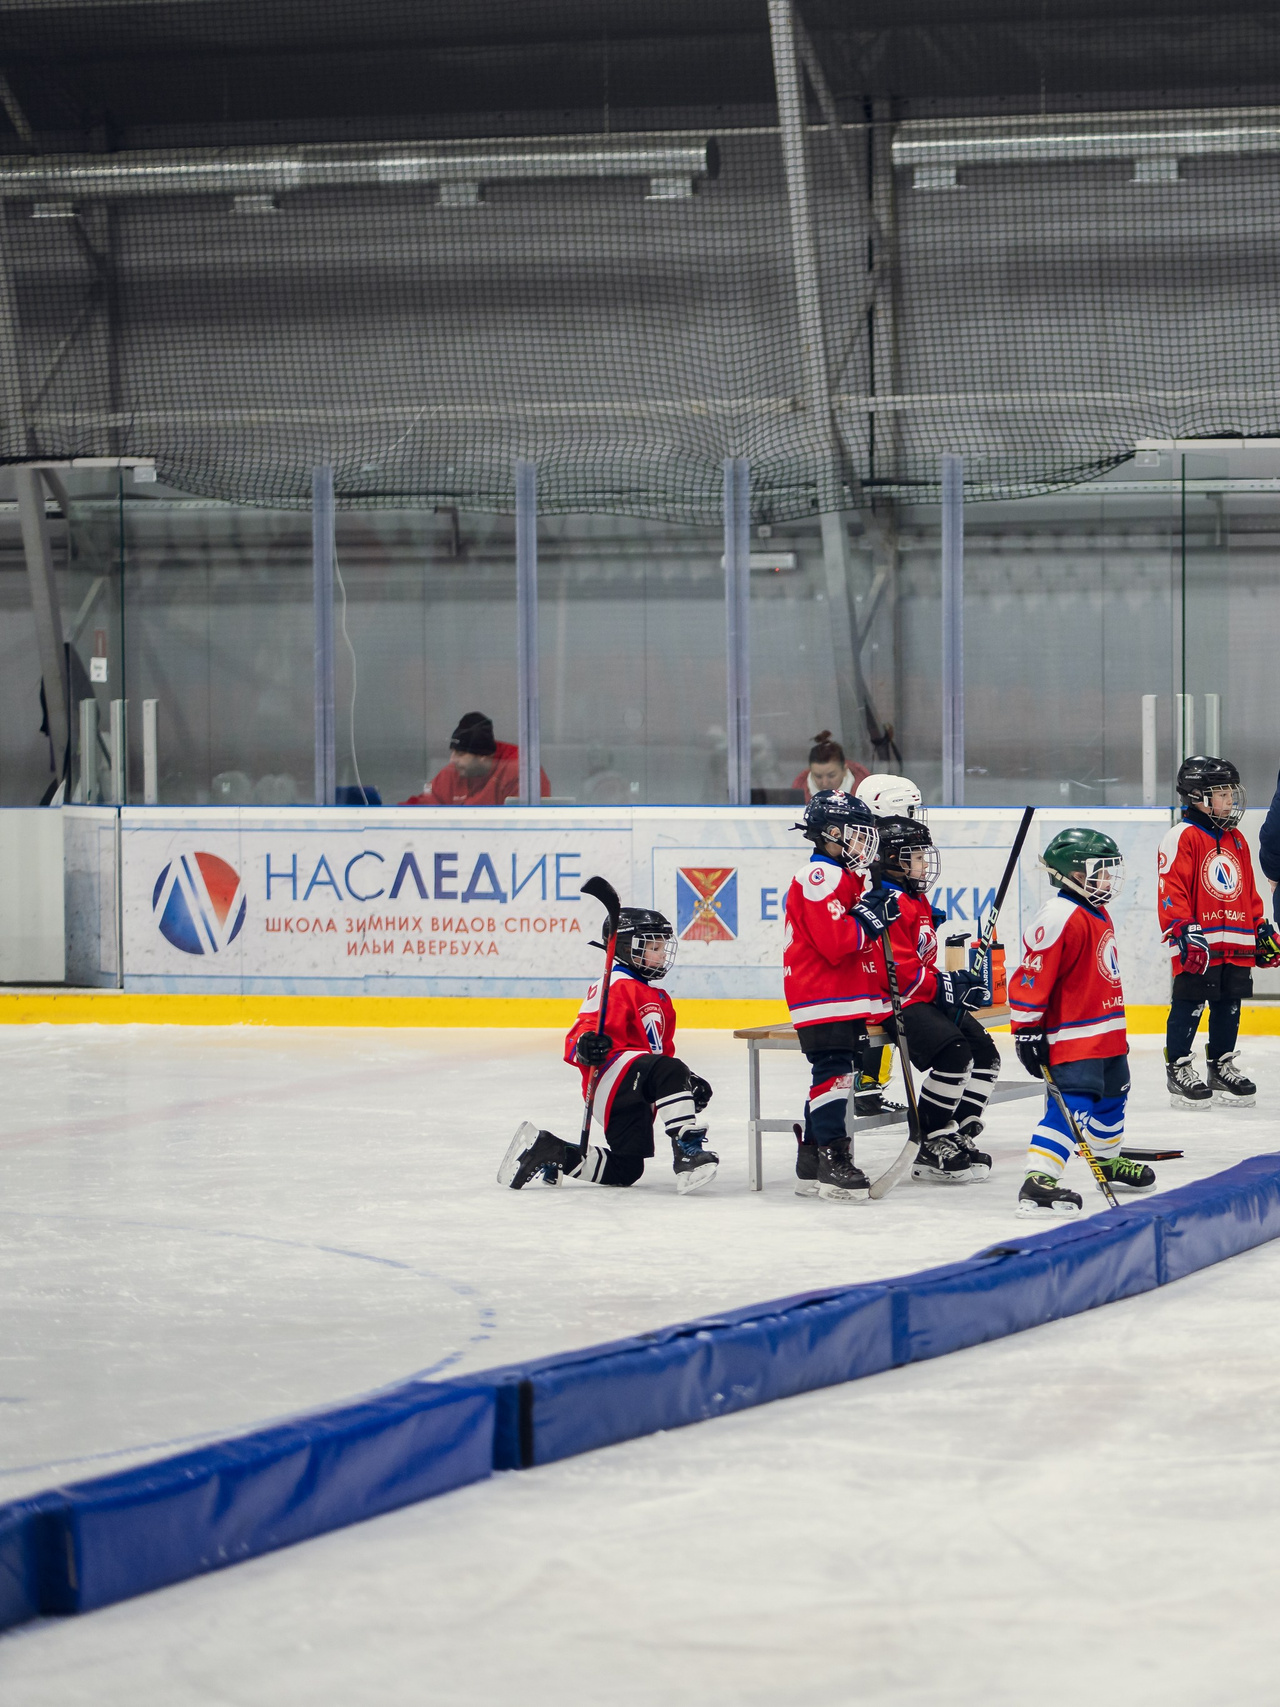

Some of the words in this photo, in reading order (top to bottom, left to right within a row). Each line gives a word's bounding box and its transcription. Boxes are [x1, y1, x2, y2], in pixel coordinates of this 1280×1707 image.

[266, 850, 581, 904] НАСЛЕДИЕ
[266, 918, 337, 932] ШКОЛА
[346, 916, 422, 933] ЗИМНИХ
[431, 917, 496, 934] ВИДОВ
[505, 917, 581, 933] СПОРТА
[347, 940, 394, 955] ИЛЬИ
[402, 940, 499, 955] АВЕРБУХА
[1021, 954, 1043, 972] 44
